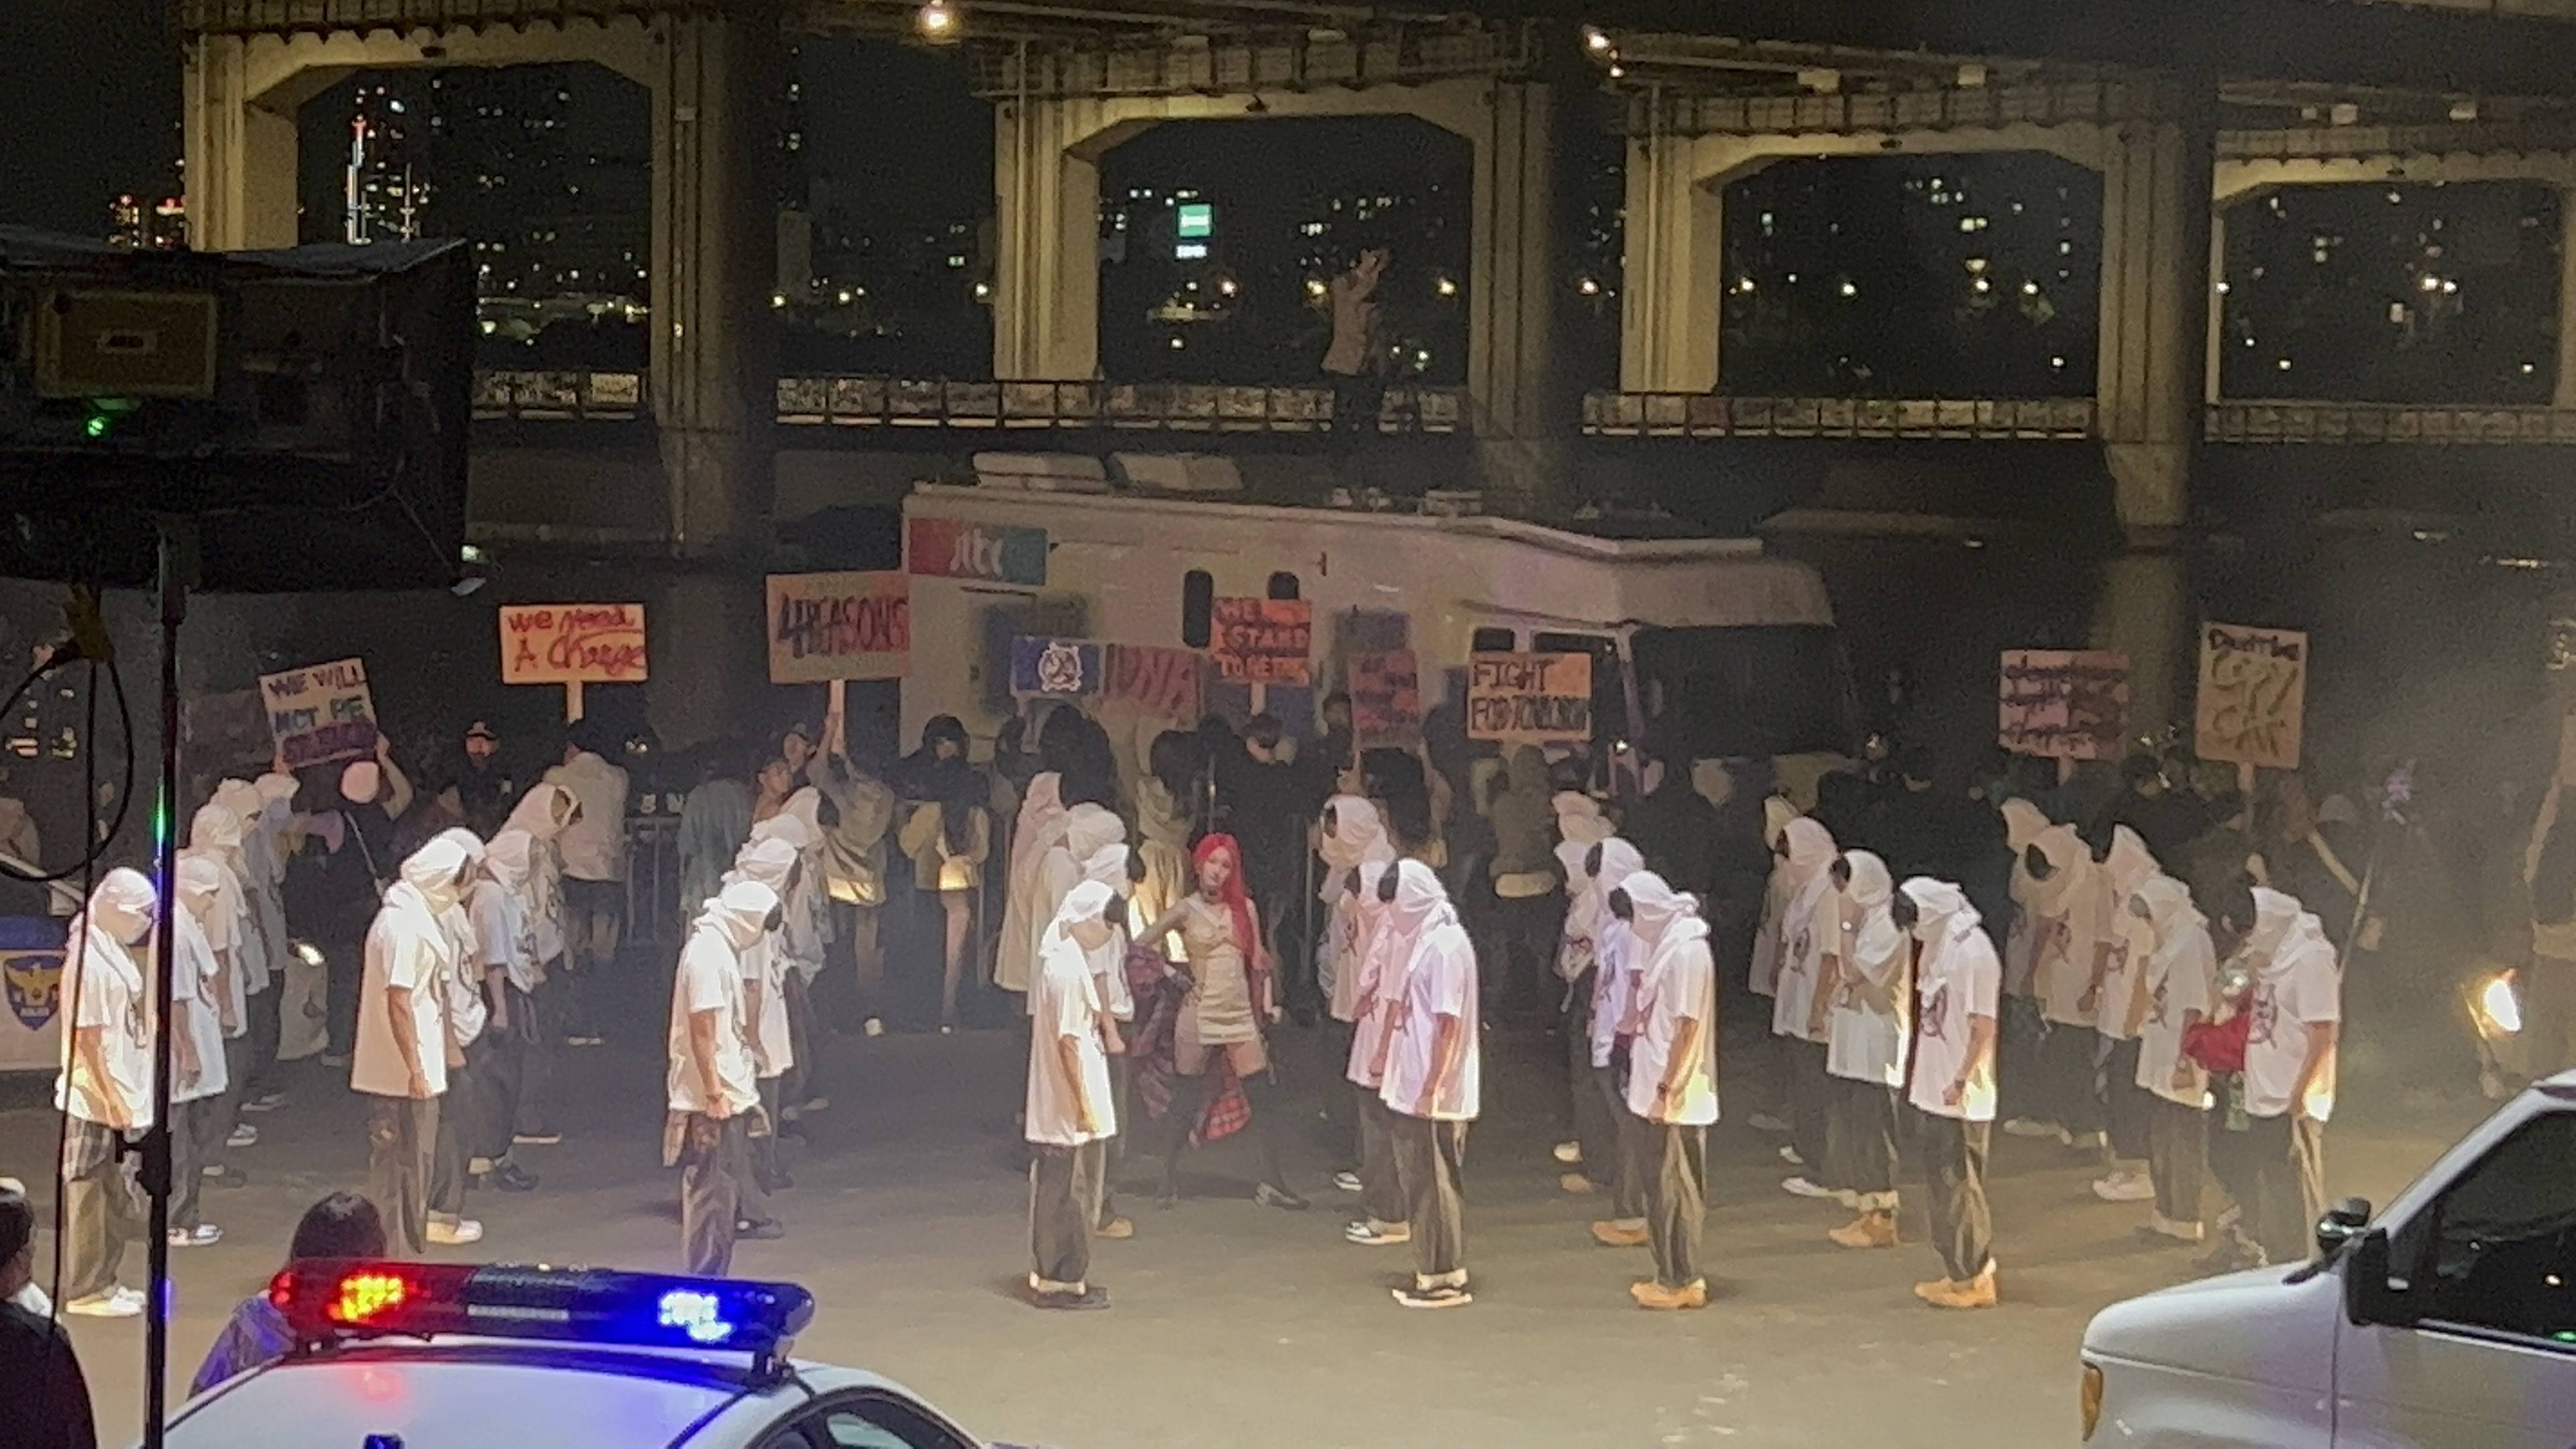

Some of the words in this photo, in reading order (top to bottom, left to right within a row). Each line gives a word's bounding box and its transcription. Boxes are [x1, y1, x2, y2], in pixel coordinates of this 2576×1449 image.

[515, 636, 538, 672] A
[268, 673, 309, 696] WE
[313, 665, 368, 690] WILL
[1473, 659, 1556, 692] FIGHT
[276, 706, 319, 733] NOT
